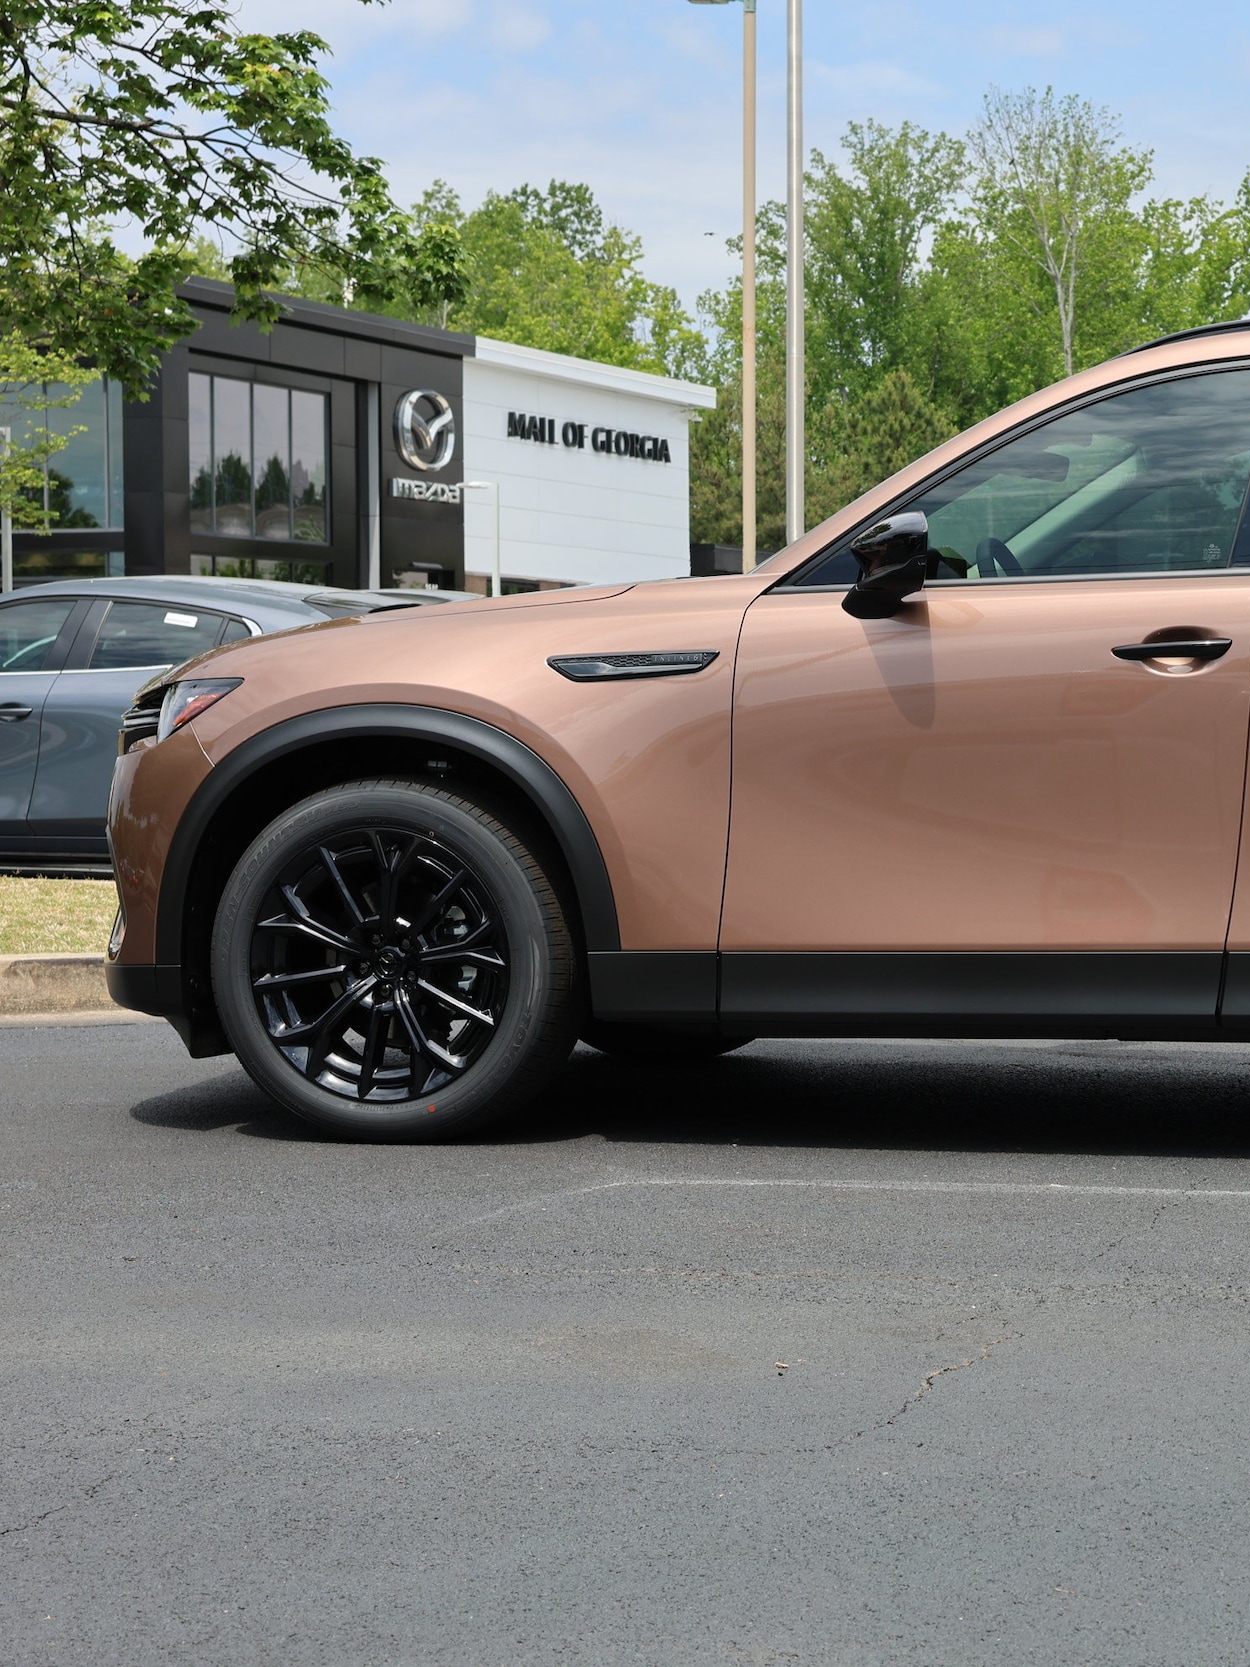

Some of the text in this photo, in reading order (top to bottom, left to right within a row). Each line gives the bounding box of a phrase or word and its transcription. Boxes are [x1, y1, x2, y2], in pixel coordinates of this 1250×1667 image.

[507, 412, 671, 463] MALL OF GEORGIA
